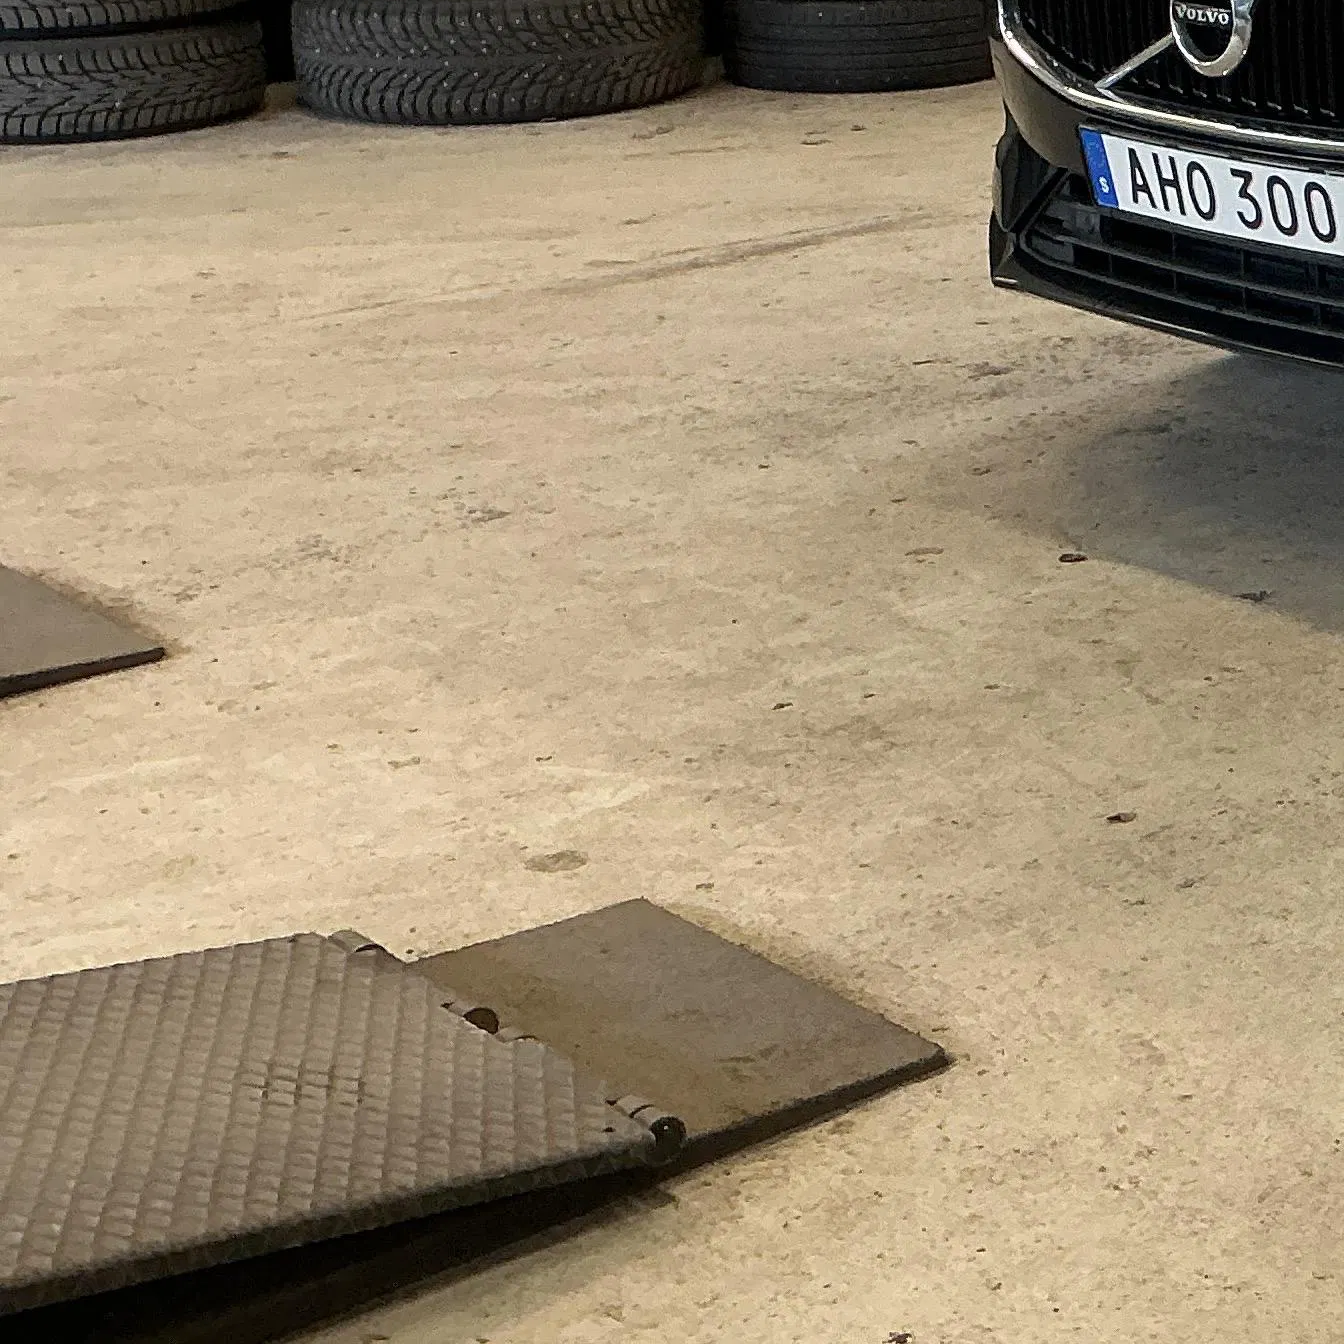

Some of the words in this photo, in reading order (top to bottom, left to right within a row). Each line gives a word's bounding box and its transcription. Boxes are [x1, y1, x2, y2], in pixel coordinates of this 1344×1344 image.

[1174, 3, 1230, 25] VOLVO
[1099, 175, 1110, 194] S
[1127, 147, 1217, 221] AHO
[1230, 167, 1337, 243] 300
